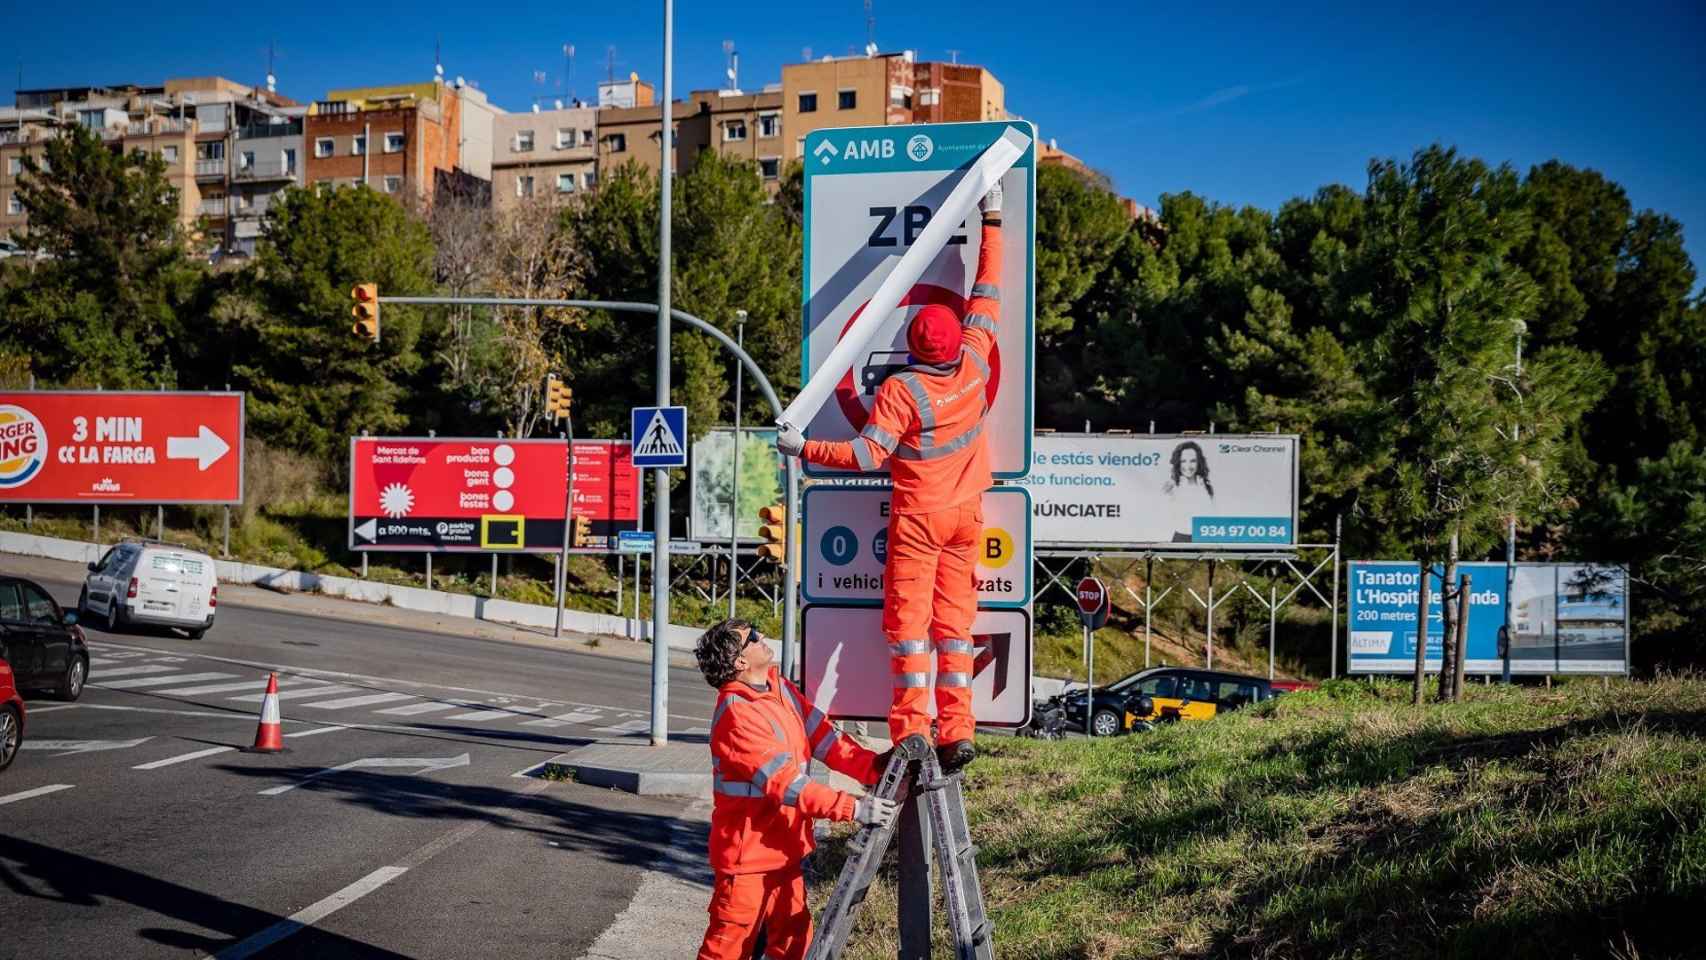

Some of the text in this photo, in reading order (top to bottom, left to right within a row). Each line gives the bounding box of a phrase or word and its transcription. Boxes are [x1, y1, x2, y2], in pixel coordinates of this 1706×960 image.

[843, 139, 895, 160] AMB
[72, 416, 142, 442] 3 MIN
[0, 435, 37, 461] NG
[79, 446, 100, 464] LA
[103, 446, 156, 464] FARGA
[471, 446, 490, 455] bon
[446, 455, 490, 464] producte
[1051, 451, 1094, 465] estás
[1098, 452, 1160, 467] viendo?
[1049, 474, 1116, 486] funciona.
[388, 525, 408, 535] 500
[409, 526, 432, 536] mts.
[1200, 525, 1287, 537] 934 97 00 84
[986, 537, 1002, 559] B
[818, 572, 823, 589] i
[1080, 590, 1100, 600] STOP
[1357, 610, 1416, 621] 200 metres
